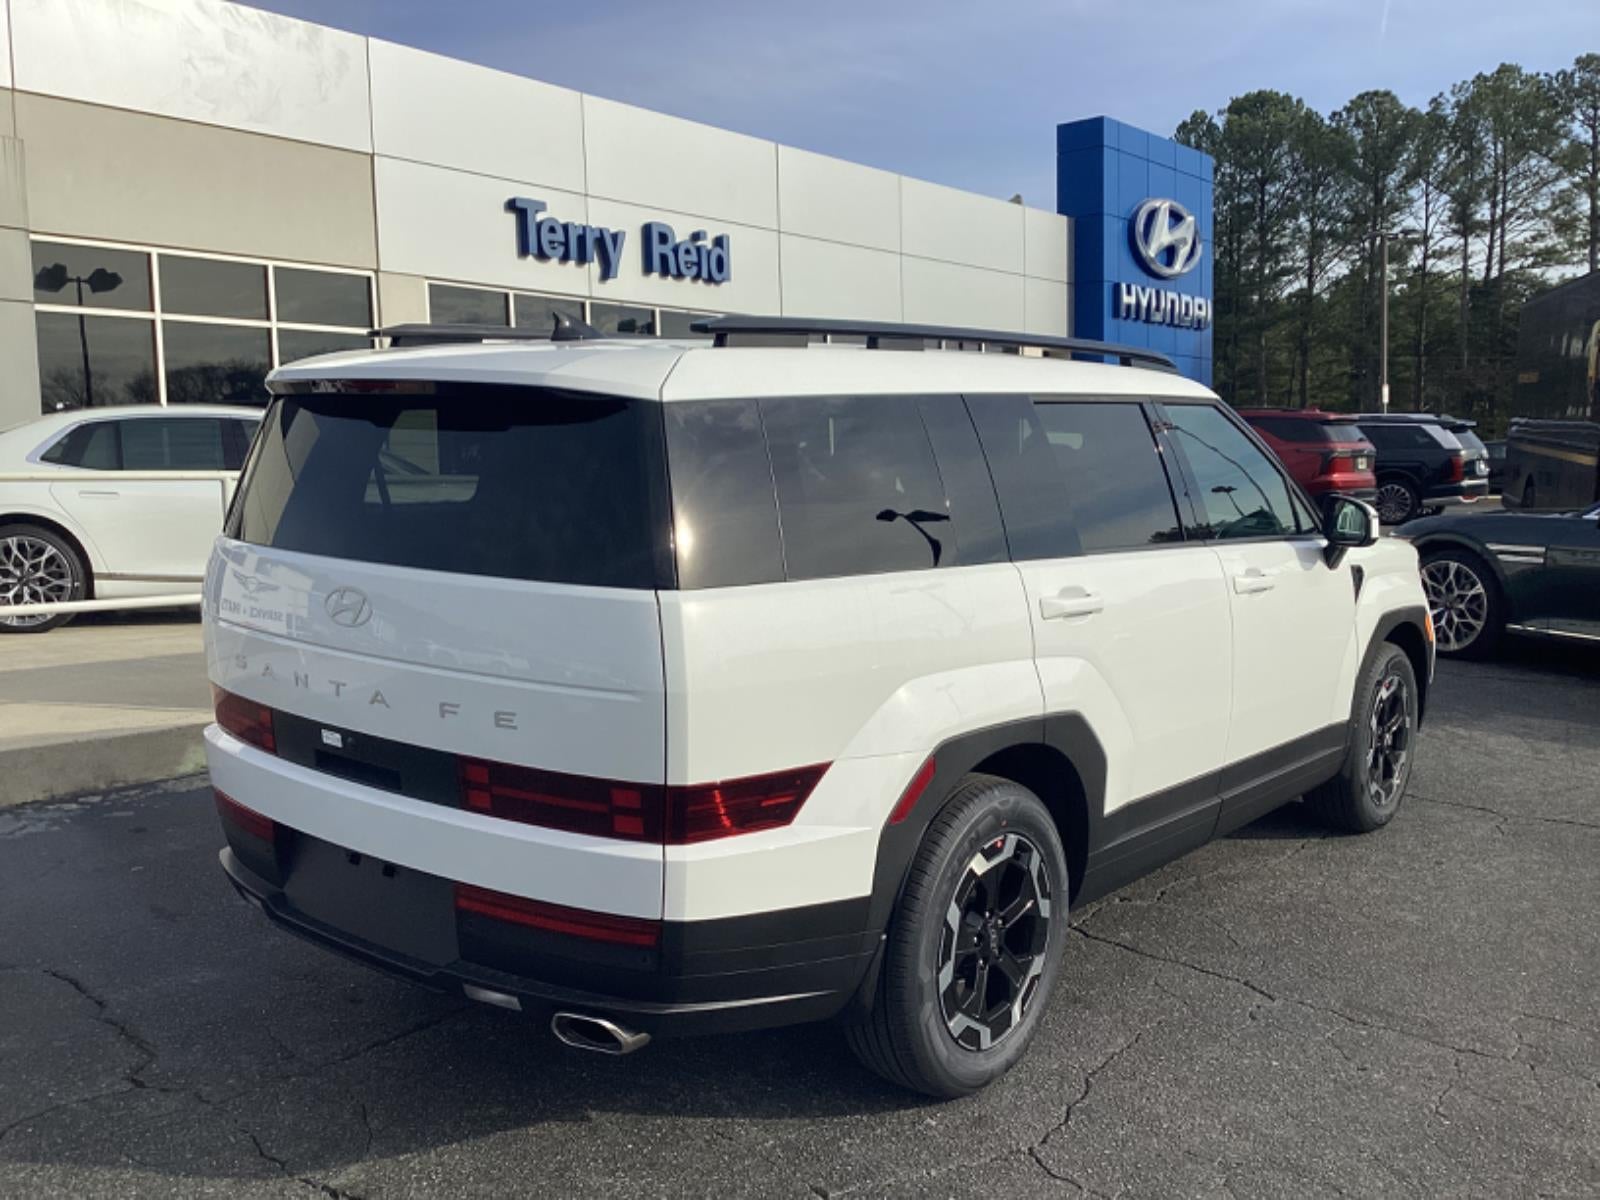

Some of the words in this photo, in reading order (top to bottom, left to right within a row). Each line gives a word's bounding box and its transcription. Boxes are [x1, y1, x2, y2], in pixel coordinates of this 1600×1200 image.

[504, 197, 626, 283] Terry
[641, 221, 731, 286] Reid
[1117, 282, 1212, 330] HYUNDAI
[236, 654, 391, 708] SANTA
[438, 702, 518, 731] FE
